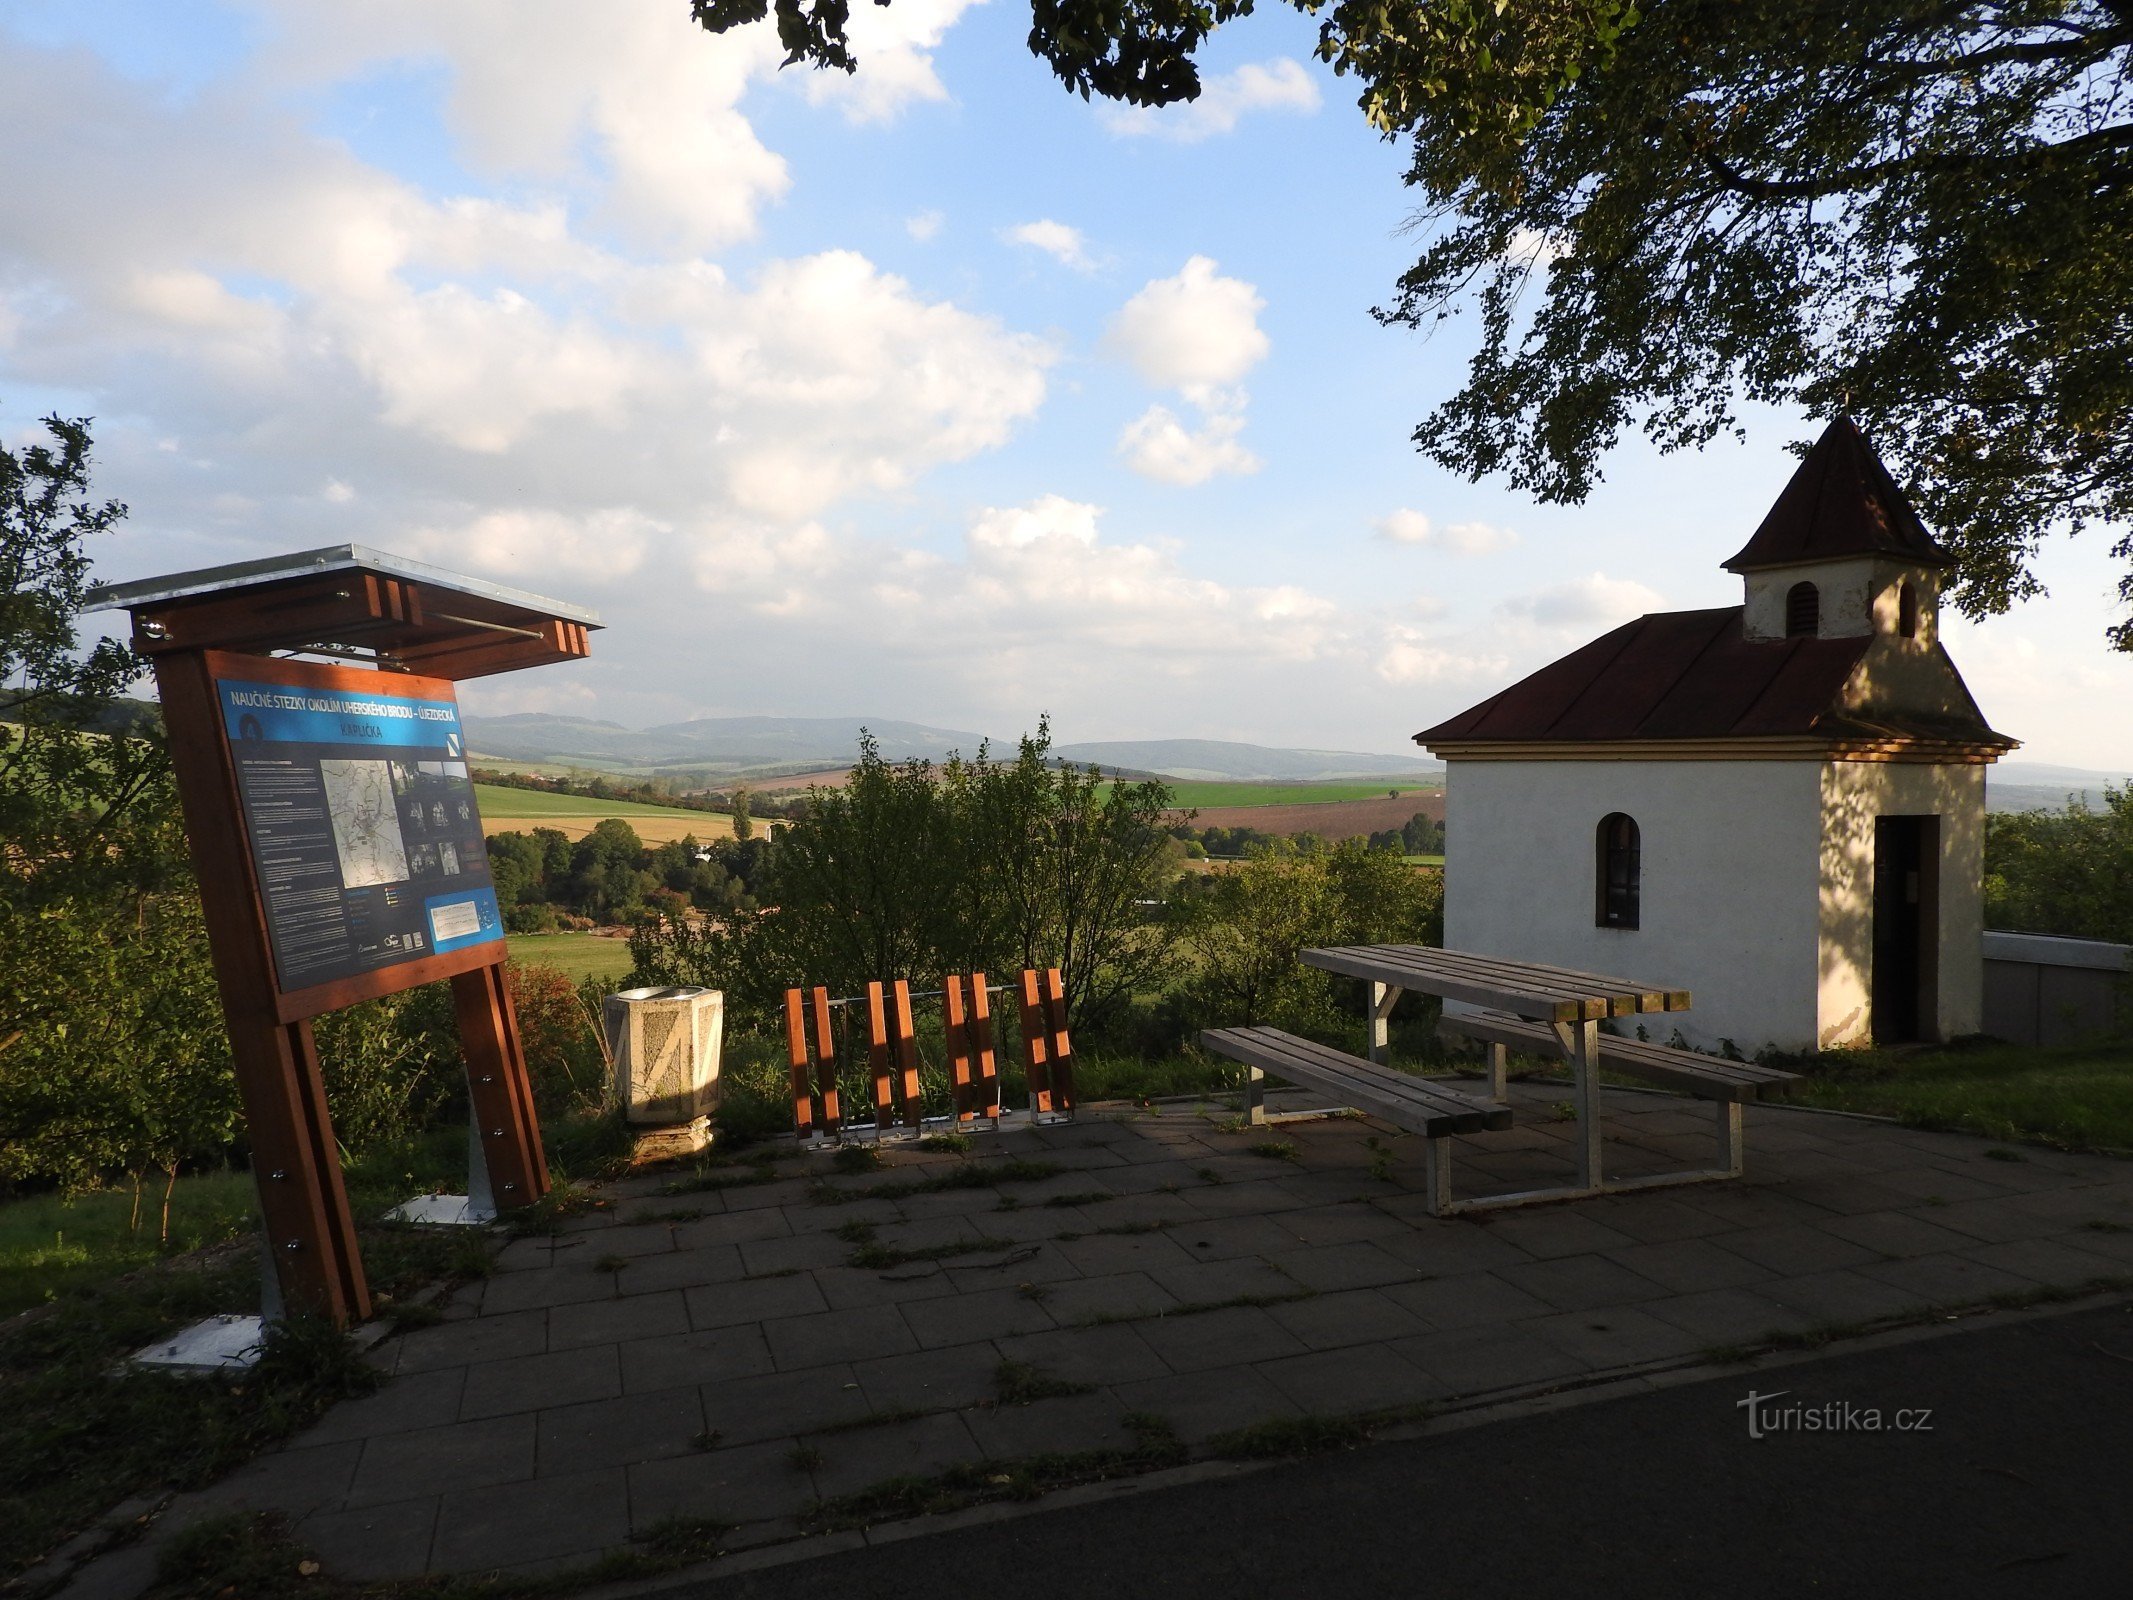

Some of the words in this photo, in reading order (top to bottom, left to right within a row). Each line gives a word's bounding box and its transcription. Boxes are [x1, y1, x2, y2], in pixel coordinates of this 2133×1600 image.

[231, 691, 273, 708] NAUČNÉ
[274, 695, 306, 710] STEZKY
[308, 697, 340, 713] OKOLÍM
[342, 701, 387, 717] UHERSKÉHO
[387, 705, 413, 719] BRODU
[341, 722, 382, 738] KAPLIČKA
